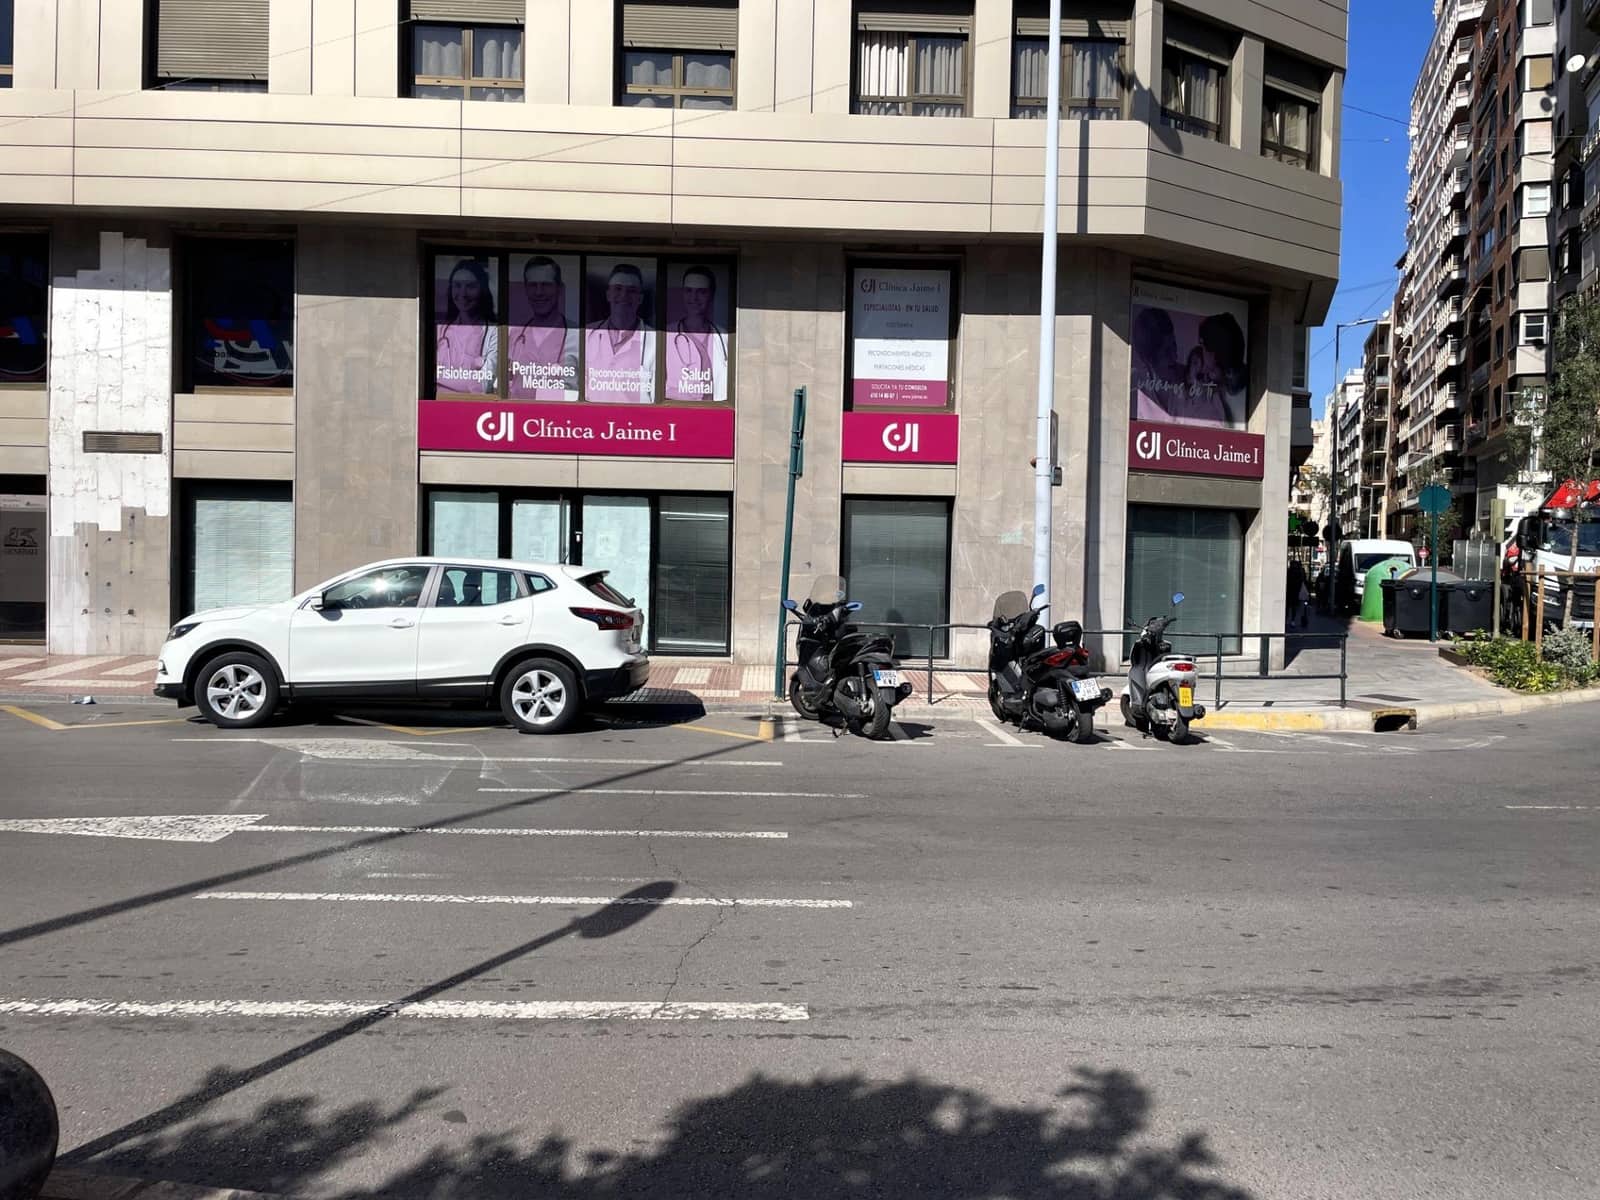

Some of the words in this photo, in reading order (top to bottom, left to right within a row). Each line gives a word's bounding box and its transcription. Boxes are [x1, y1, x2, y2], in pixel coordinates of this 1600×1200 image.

[436, 365, 493, 382] Fisioterapia
[512, 361, 576, 377] Peritaciones
[681, 367, 711, 381] Salud
[522, 373, 566, 390] Médicas
[590, 377, 654, 393] Conductores
[678, 379, 713, 394] Mental
[522, 418, 595, 439] Clínica
[600, 421, 664, 441] Jaime
[668, 423, 677, 441] I
[1165, 439, 1211, 460] Clínica
[1213, 444, 1251, 464] Jaime
[1253, 447, 1259, 464] I
